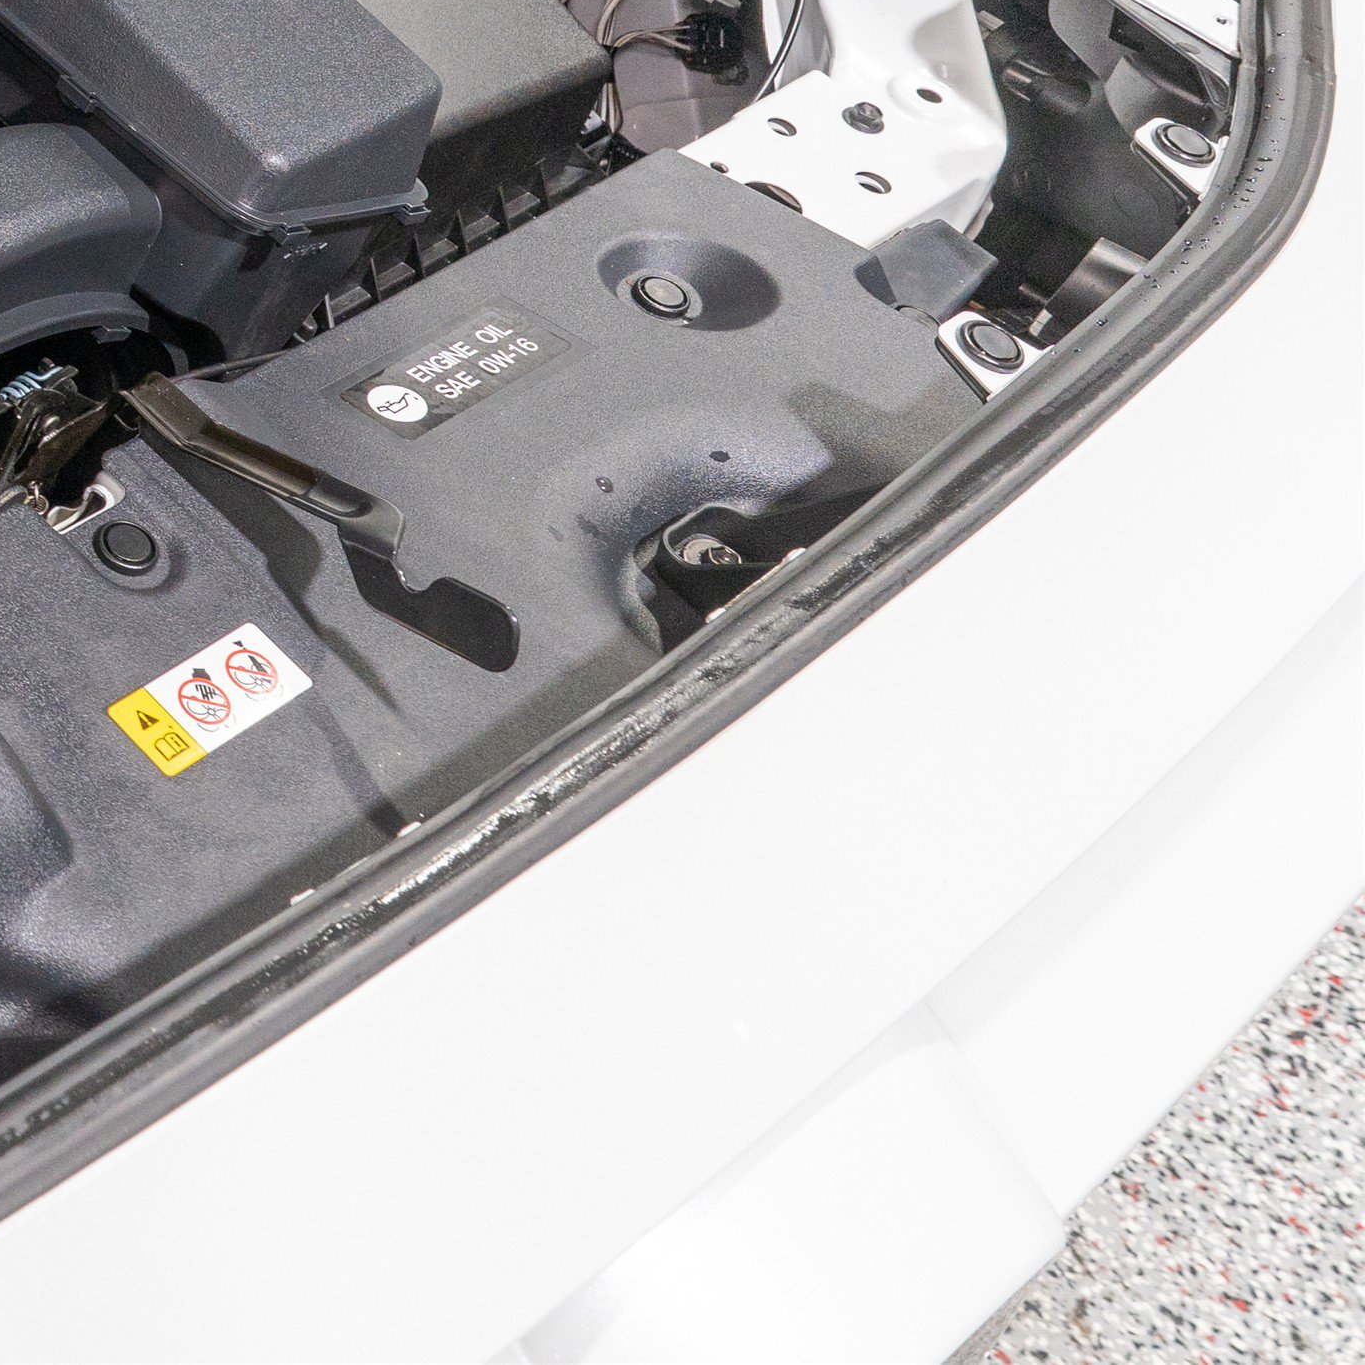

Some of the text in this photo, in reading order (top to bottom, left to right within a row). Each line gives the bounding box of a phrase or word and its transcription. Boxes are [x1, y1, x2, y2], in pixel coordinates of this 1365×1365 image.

[405, 324, 514, 383] ENGINE OIL
[434, 337, 539, 399] SAE 0W-16
